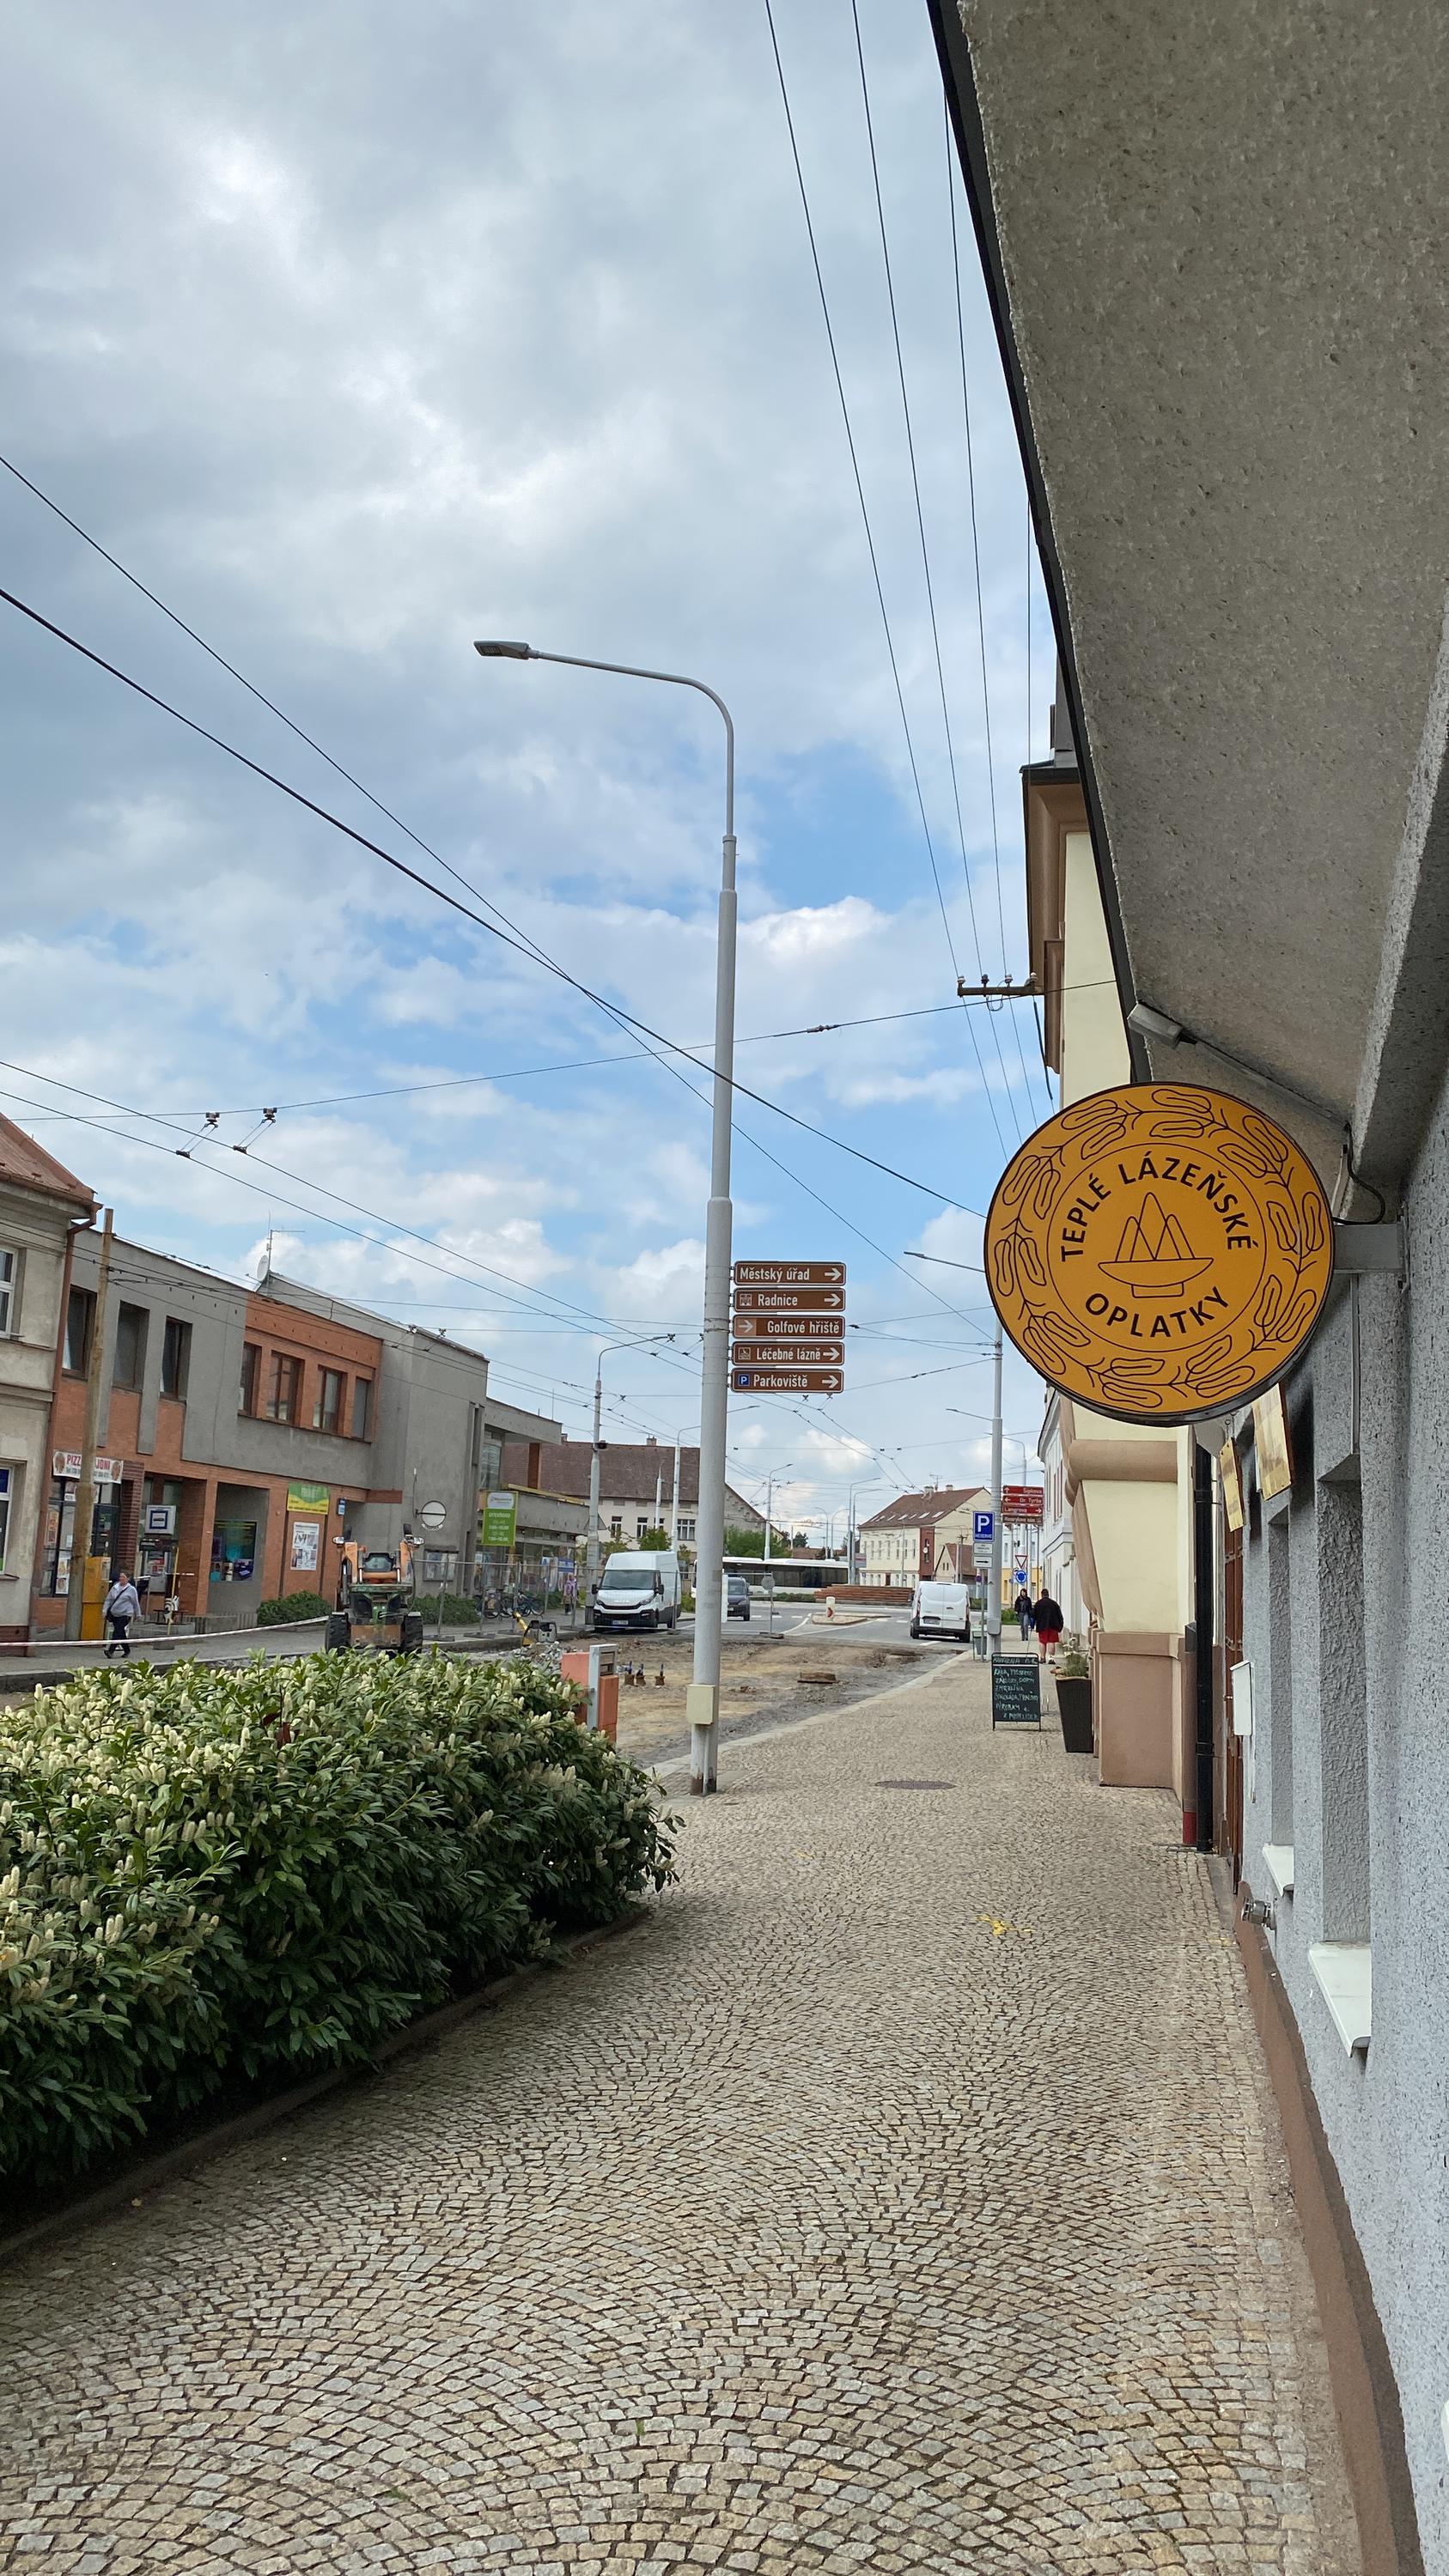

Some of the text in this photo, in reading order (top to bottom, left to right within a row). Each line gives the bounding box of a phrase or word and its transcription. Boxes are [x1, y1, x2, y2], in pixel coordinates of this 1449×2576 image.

[1061, 1151, 1259, 1262] TEPLÉ LÁZEŇSKÉ
[740, 1267, 810, 1283] Městský úřad
[758, 1293, 798, 1306] Radnice
[1085, 1285, 1229, 1338] OPLATKY
[767, 1321, 840, 1334] Golfové hřiště
[757, 1347, 821, 1360] Léčebné lázně
[753, 1374, 808, 1388] Parkoviště
[977, 1515, 990, 1533] P
